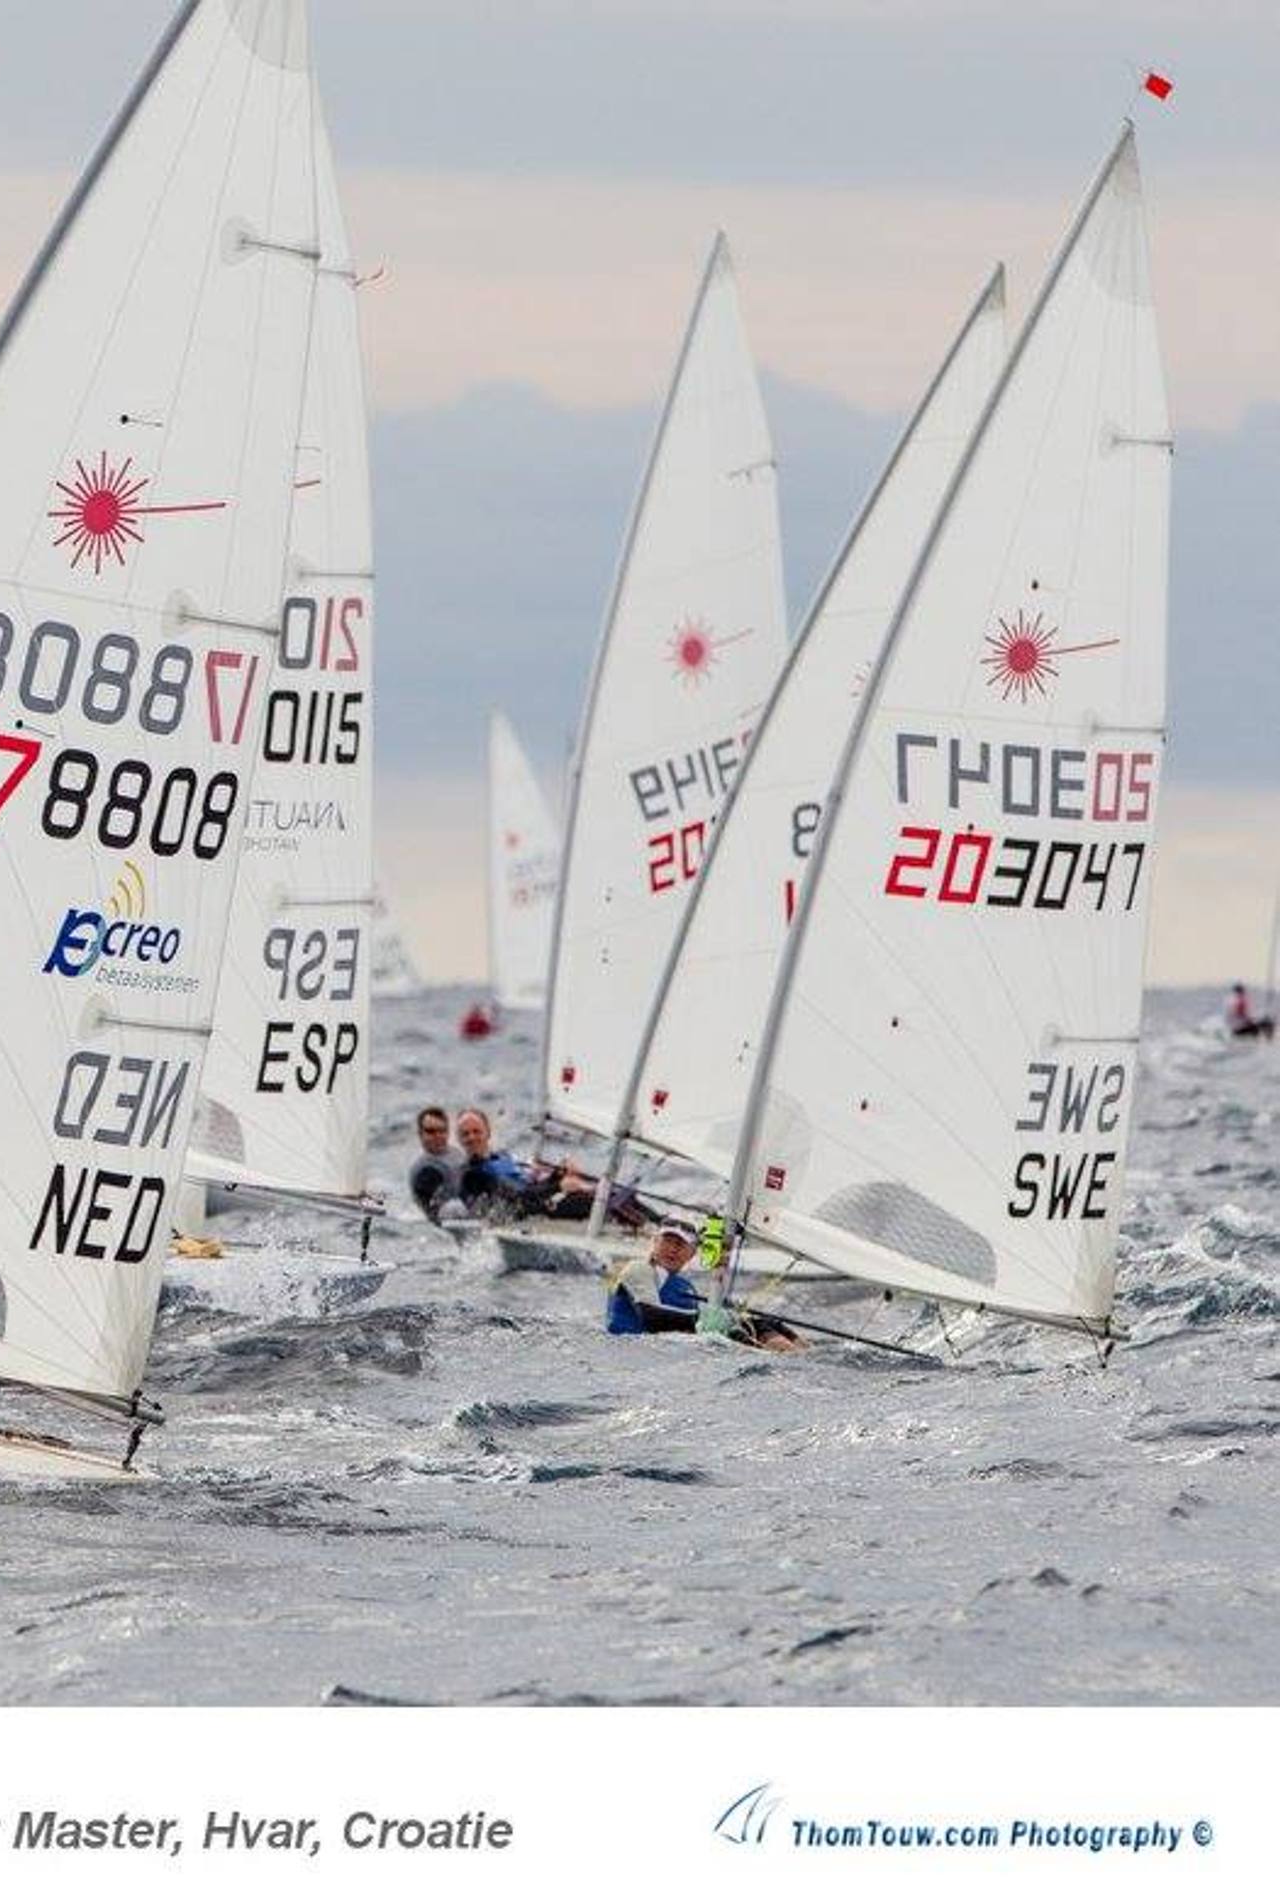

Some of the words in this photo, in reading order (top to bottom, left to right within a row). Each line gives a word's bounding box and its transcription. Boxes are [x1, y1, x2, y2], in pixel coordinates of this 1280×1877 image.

[263, 690, 363, 764] 0115
[885, 826, 1145, 910] 203047
[256, 1022, 359, 1094] ESP
[29, 1163, 166, 1264] NED
[1008, 1152, 1117, 1220] SWE
